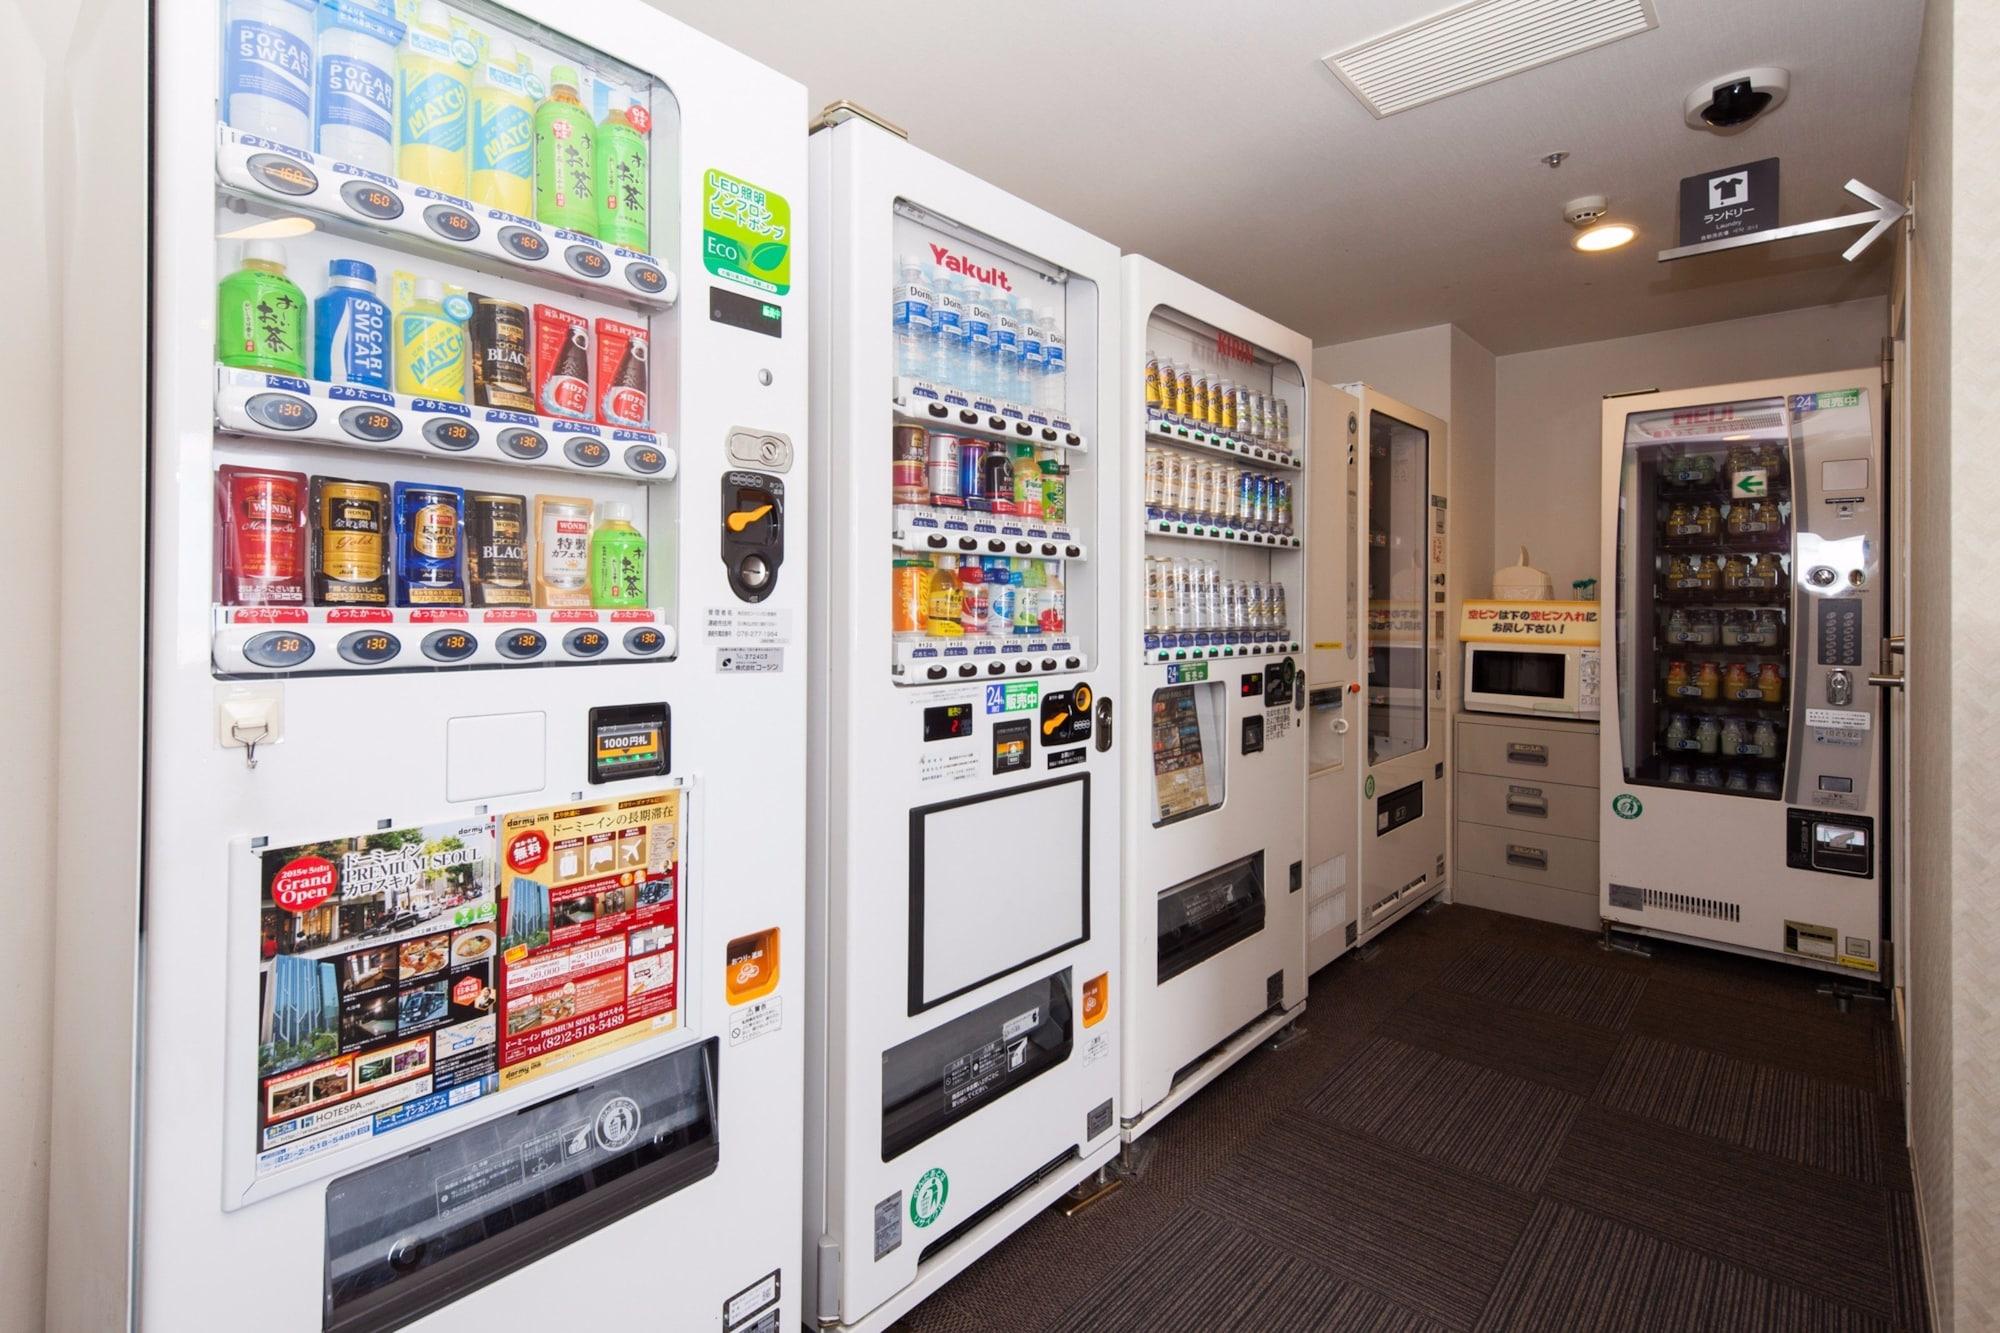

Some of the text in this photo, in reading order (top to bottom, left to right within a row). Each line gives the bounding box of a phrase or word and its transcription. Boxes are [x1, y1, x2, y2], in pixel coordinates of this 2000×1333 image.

[711, 173, 765, 207] LED照明
[370, 192, 390, 207] 160
[711, 190, 771, 221] ノンフロン
[710, 203, 785, 239] ヒートポンプ
[1703, 207, 1755, 225] ランドリー
[450, 218, 468, 229] 160
[1716, 220, 1743, 230] Laundry
[521, 237, 539, 249] 160
[707, 236, 738, 261] ECO
[585, 255, 601, 267] 150
[644, 271, 657, 283] 150
[256, 301, 294, 353] お茶
[354, 299, 369, 370] SWEAT
[369, 302, 383, 379] POCARI
[1818, 396, 1859, 408] 販売中
[280, 403, 302, 417] 130
[368, 415, 389, 428] 130
[448, 426, 467, 439] 130
[520, 436, 537, 447] 130
[585, 444, 599, 456] 120
[643, 453, 657, 463] 120
[336, 536, 373, 551] Gold
[557, 537, 586, 551] 特製
[621, 557, 642, 597] お茶
[1468, 609, 1598, 622] 空ビンは下の空ビン入れに
[276, 639, 299, 652] 130
[367, 638, 388, 650] 130
[447, 637, 465, 648] 130
[519, 635, 535, 646] 130
[583, 634, 598, 644] 130
[642, 634, 656, 643] 130
[1006, 691, 1038, 711] 販売中
[603, 735, 648, 749] 1000円札
[507, 813, 549, 828] dormy inn
[552, 805, 674, 837] ドーミーインの長期滞在
[458, 825, 483, 836] dormy
[345, 844, 425, 869] ドーミーイン
[344, 849, 483, 883] PREMIUM SEOUL
[276, 871, 332, 893] Grand
[344, 874, 418, 898] カロスキル
[281, 887, 328, 906] Open
[541, 1023, 574, 1039] PREMIUM
[575, 1015, 596, 1027] SEOUL
[527, 1044, 541, 1056] Tel
